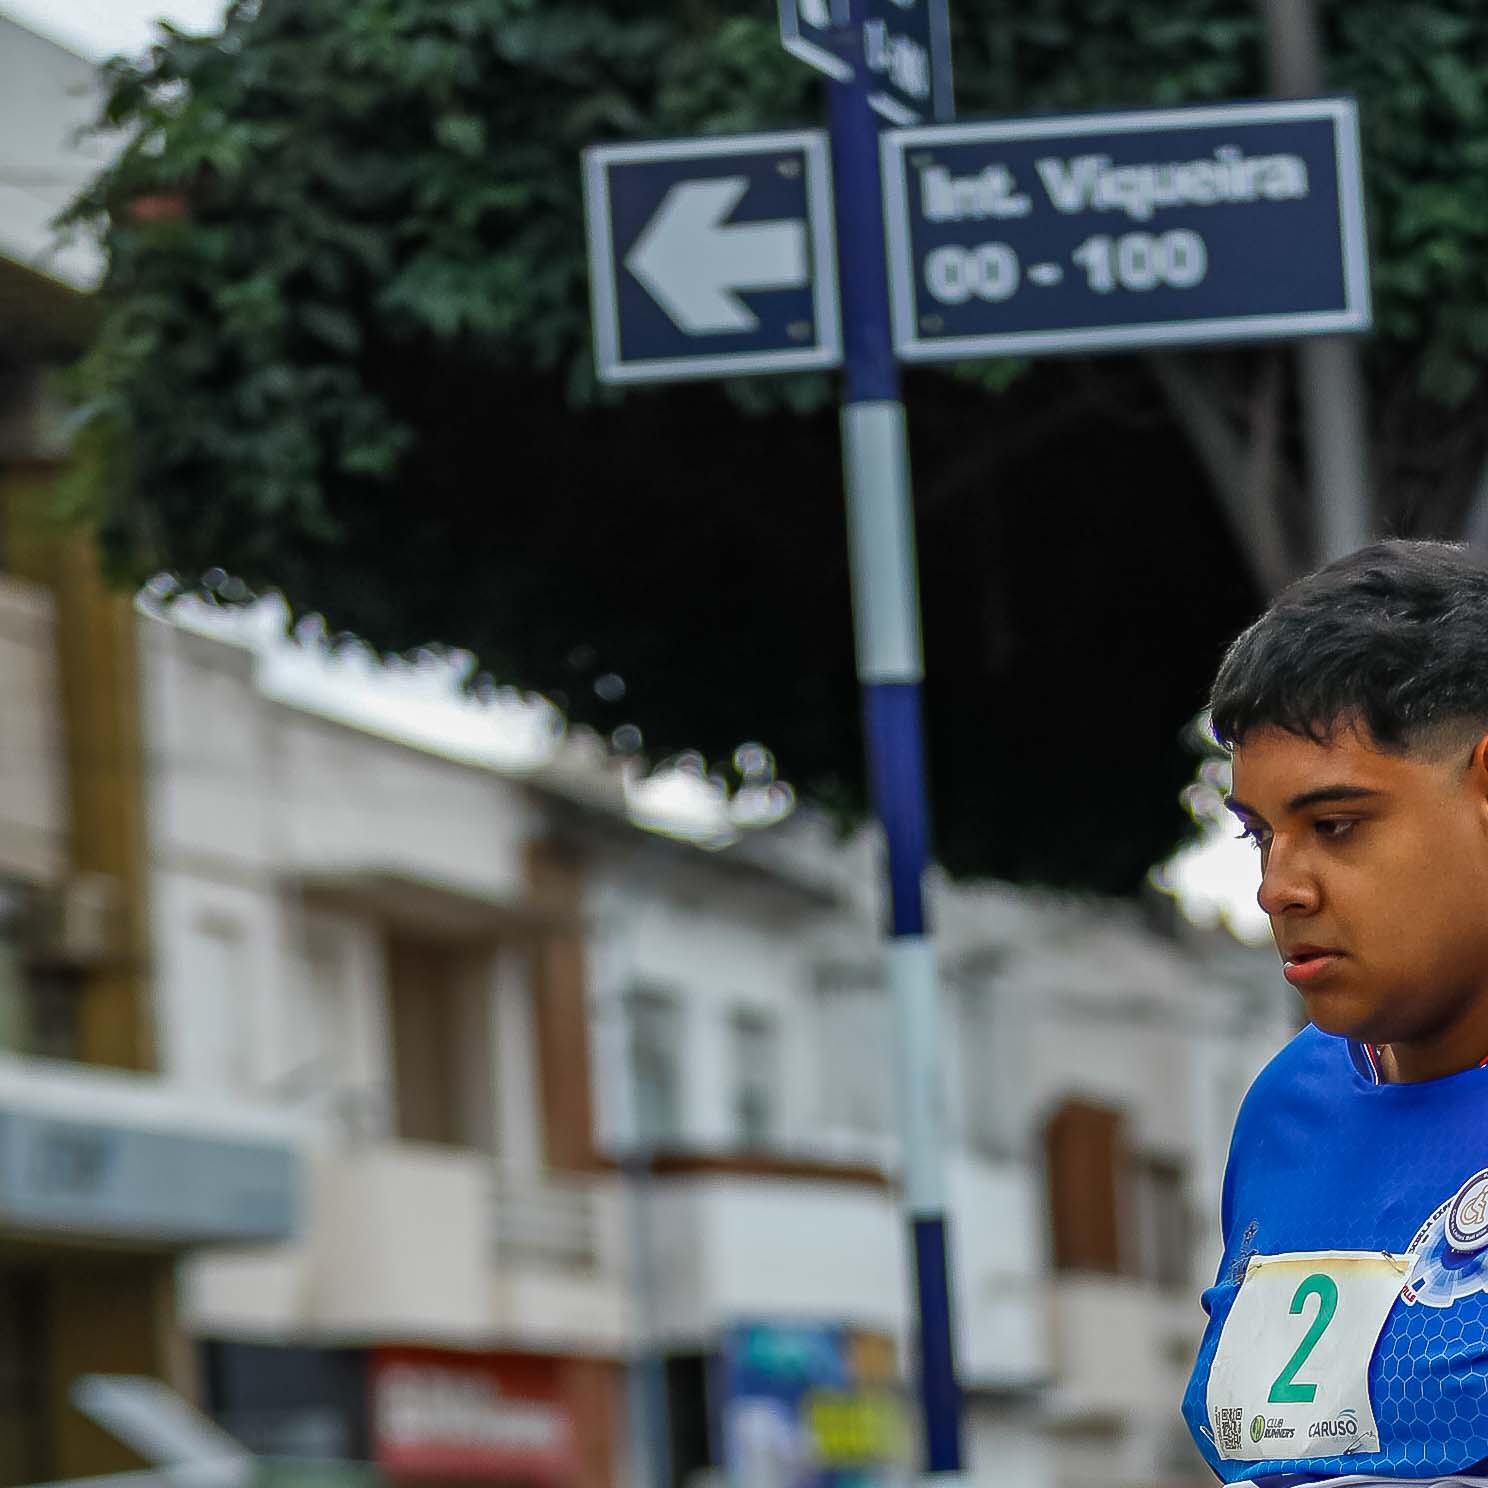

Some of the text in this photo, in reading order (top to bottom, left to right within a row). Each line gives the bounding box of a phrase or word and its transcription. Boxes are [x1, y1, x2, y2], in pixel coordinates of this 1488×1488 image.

[921, 145, 1309, 223] Int. Viqueira
[924, 241, 1020, 305] 00
[1072, 228, 1208, 293] 100
[1267, 1273, 1339, 1404] 2
[1266, 1418, 1284, 1428] CLUB
[1308, 1420, 1358, 1438] CARUSO
